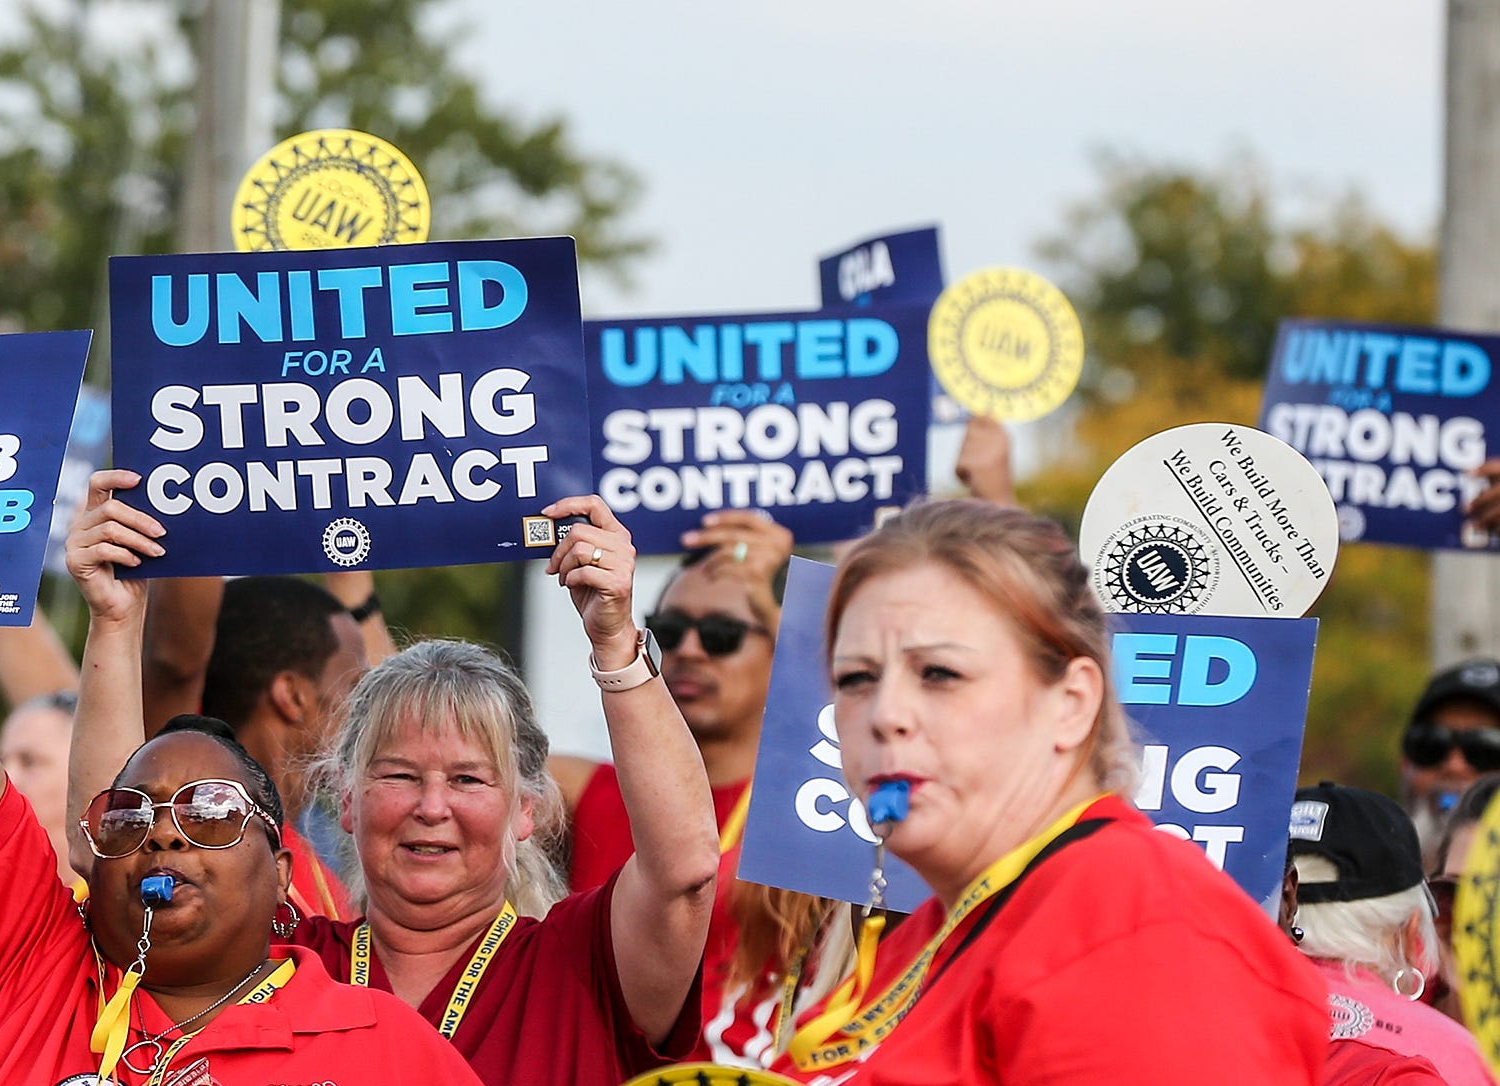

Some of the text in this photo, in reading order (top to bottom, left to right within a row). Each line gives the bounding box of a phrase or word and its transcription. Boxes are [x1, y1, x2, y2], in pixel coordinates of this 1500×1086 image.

[292, 188, 373, 243] UAW
[151, 259, 528, 347] UNITED
[281, 347, 386, 377] FOR A
[601, 318, 900, 387] UNITED
[1281, 328, 1492, 398] UNITED
[149, 368, 536, 451] STRONG
[602, 399, 899, 466] STRONG
[1267, 402, 1487, 471] STRONG
[146, 445, 549, 516] CONTRACT
[599, 455, 903, 513] CONTRACT
[1209, 460, 1237, 497] Cars
[1233, 496, 1250, 512] &
[1245, 510, 1284, 564] Trucks
[1221, 428, 1325, 580] We Build More Than
[1170, 448, 1285, 612] We Build Communities
[1137, 550, 1180, 592] UAW
[453, 911, 514, 1007] FIGHTING FOR THE
[810, 1046, 851, 1064] FOR
